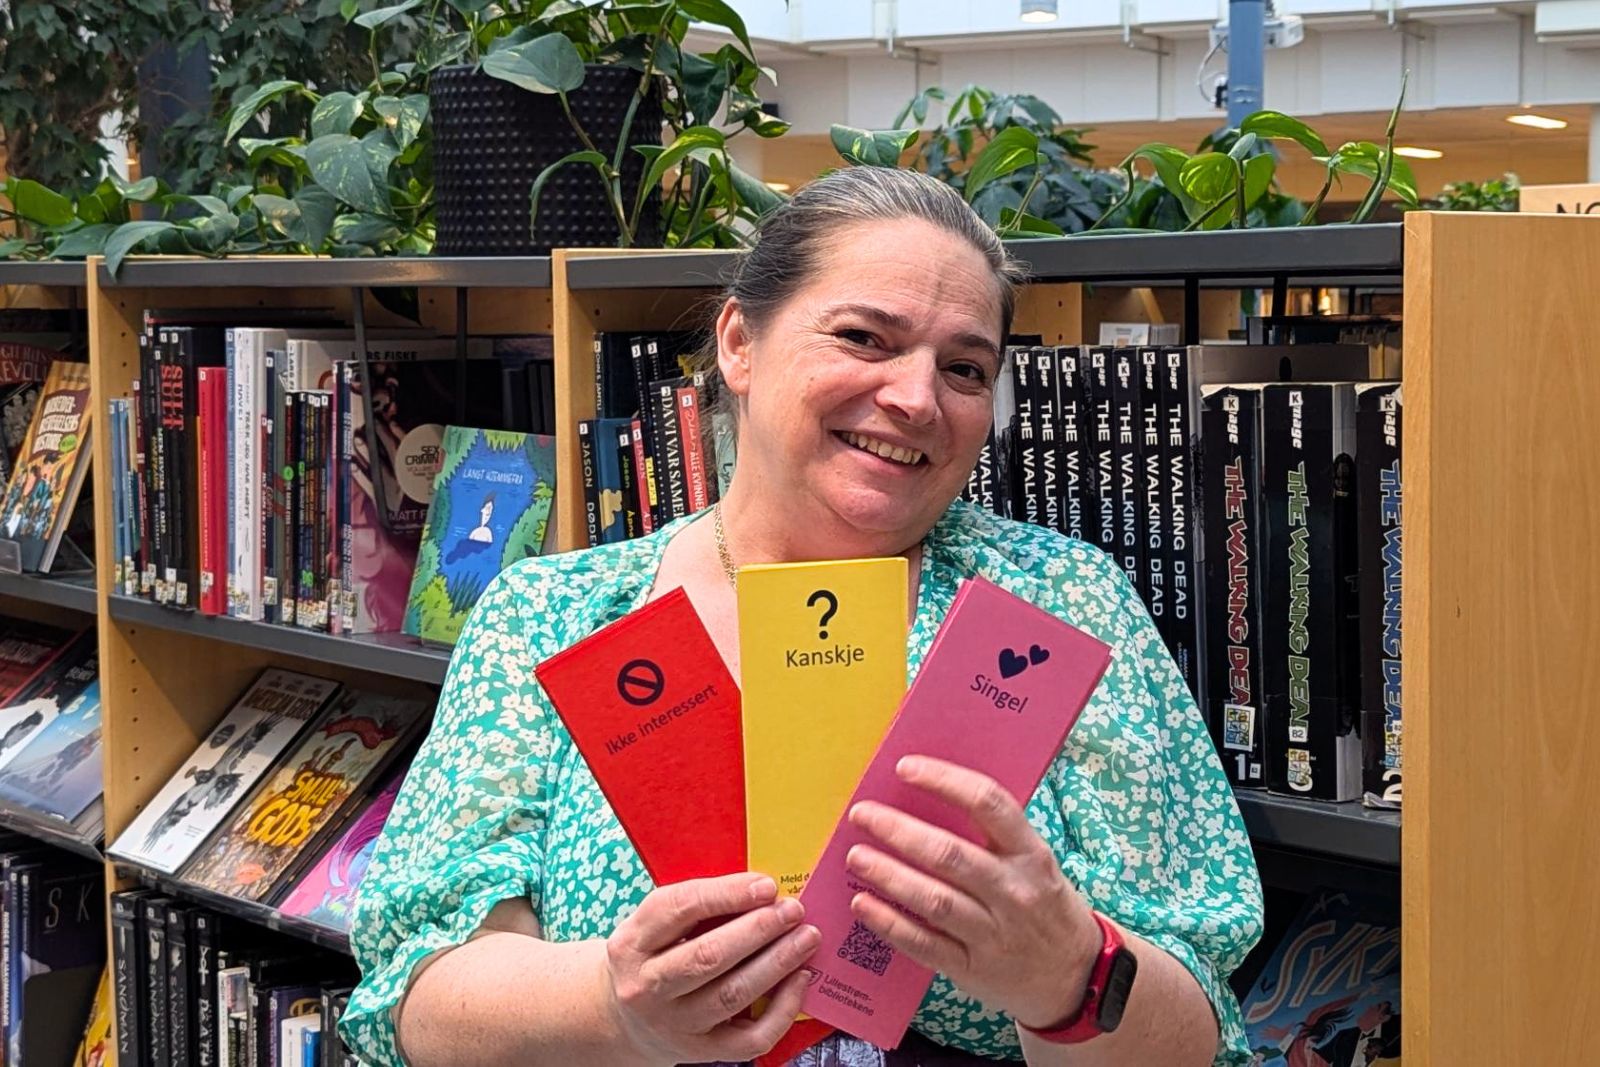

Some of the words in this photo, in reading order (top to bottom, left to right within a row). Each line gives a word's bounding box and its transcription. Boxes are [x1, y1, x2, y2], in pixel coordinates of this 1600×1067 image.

[351, 350, 380, 361] LRS
[384, 350, 418, 361] FISKE
[661, 396, 673, 418] DA
[664, 418, 677, 436] VI
[1020, 398, 1033, 440] THE
[1041, 400, 1054, 442] THE
[1064, 400, 1078, 443] THE
[1097, 400, 1110, 442] THE
[1119, 401, 1132, 444] THE
[1144, 403, 1158, 446] THE
[1168, 403, 1182, 447] THE
[421, 445, 440, 455] SEX
[582, 442, 593, 487] JASON
[665, 437, 680, 470] VAR
[689, 451, 700, 471] ALLE
[1099, 449, 1114, 543] WALKING
[1121, 452, 1136, 547] WALKING
[1146, 454, 1162, 549] WALKING
[1170, 455, 1186, 551] WALKING
[1224, 455, 1247, 519] THE
[1287, 460, 1310, 527] THE
[1380, 458, 1402, 526] THE
[587, 502, 598, 547] DØDE
[1151, 558, 1163, 616] DEAD
[1174, 561, 1187, 619] DEAD
[1226, 519, 1249, 644] WALKING
[1288, 526, 1310, 654] WALKING
[1382, 526, 1402, 658] WALKING
[786, 644, 865, 668] Kanskje
[969, 673, 1029, 714] Singel
[604, 726, 637, 757] Ikke
[636, 683, 719, 740] interessert
[286, 771, 343, 806] SMALL
[1235, 753, 1246, 780] 1
[250, 797, 323, 848] GODS
[780, 873, 803, 884] Meld
[119, 958, 130, 1055] SANDMAN
[818, 986, 875, 1016] bibliotekene
[823, 974, 873, 1001] Lillestrøm-
[149, 963, 161, 1061] SANDMAN
[171, 975, 182, 1067] SANDMAN
[199, 998, 210, 1067] DEATH
